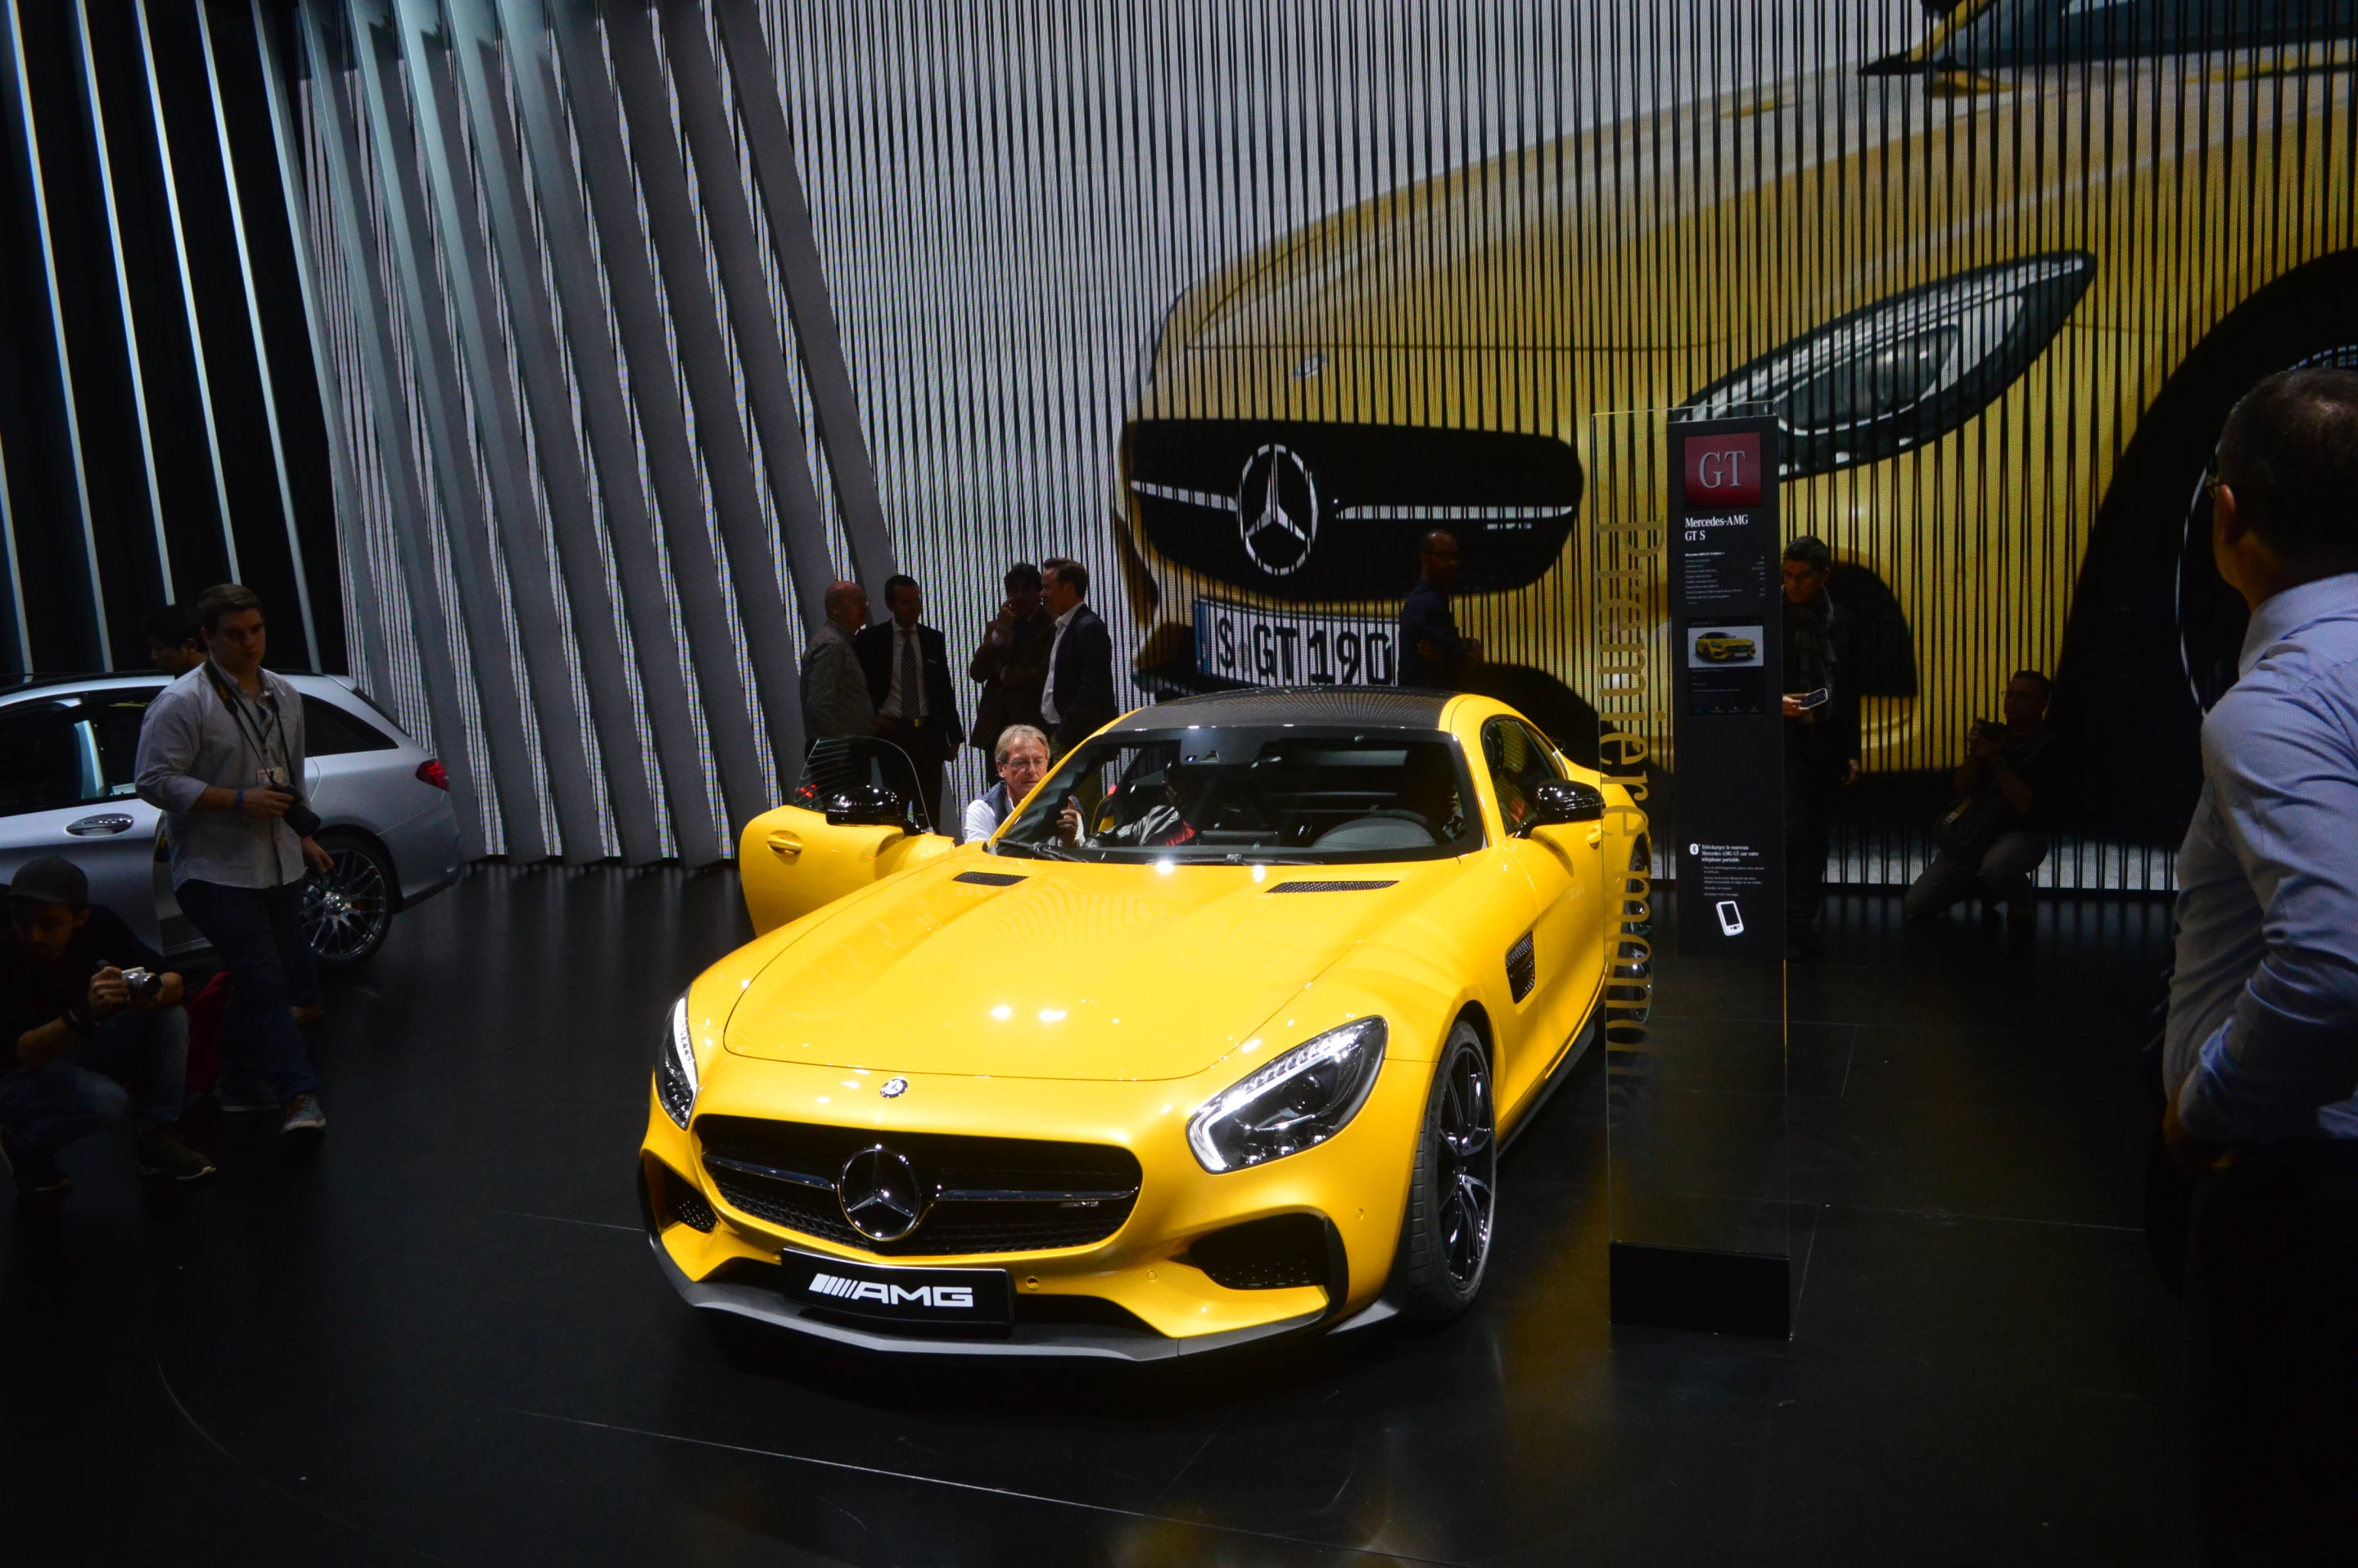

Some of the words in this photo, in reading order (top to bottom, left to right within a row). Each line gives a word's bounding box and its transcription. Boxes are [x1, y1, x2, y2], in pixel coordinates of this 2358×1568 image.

[1699, 450, 1746, 489] GT
[1685, 514, 1749, 528] Mercedes-AMG
[1685, 531, 1697, 541] GT
[1699, 530, 1706, 540] S
[1218, 617, 1233, 669] S
[1253, 623, 1297, 680] GT
